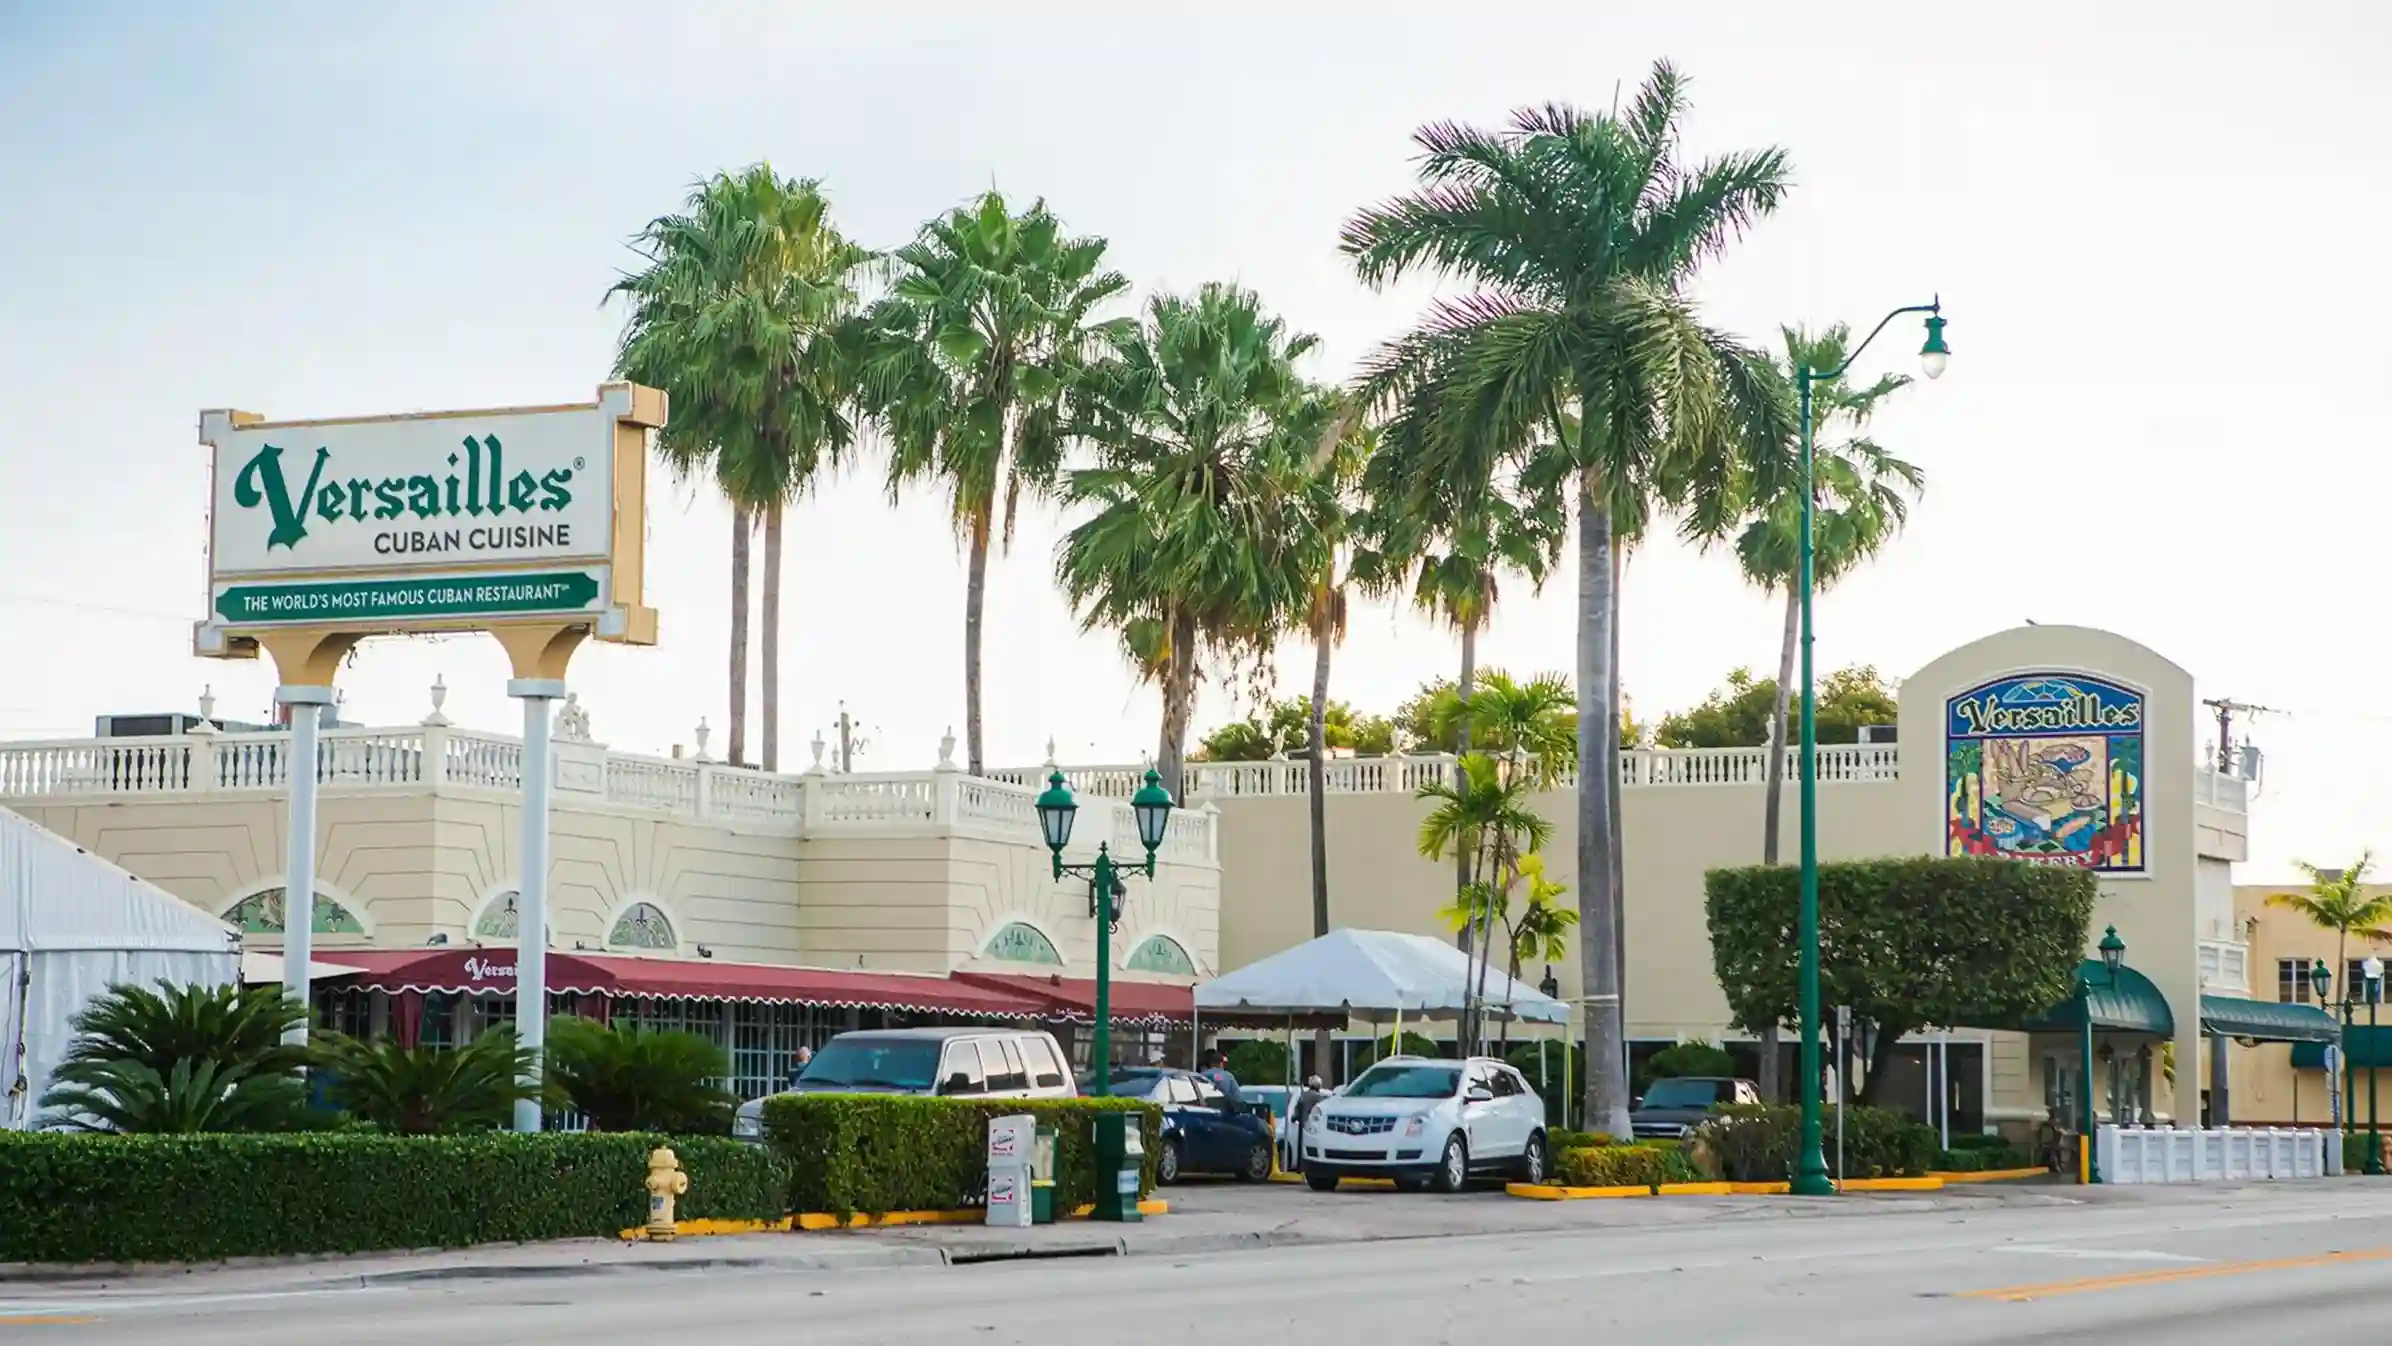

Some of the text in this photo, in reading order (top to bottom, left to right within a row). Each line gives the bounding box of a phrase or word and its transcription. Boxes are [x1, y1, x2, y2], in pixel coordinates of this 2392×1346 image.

[374, 524, 570, 555] CUBAN CUISINE
[243, 595, 268, 612] THE
[271, 591, 330, 611] WORLD'S
[331, 591, 368, 609] MOST
[371, 588, 425, 608] FAMOUS
[427, 586, 474, 605] CUBAN
[1956, 694, 2140, 734] Versailles
